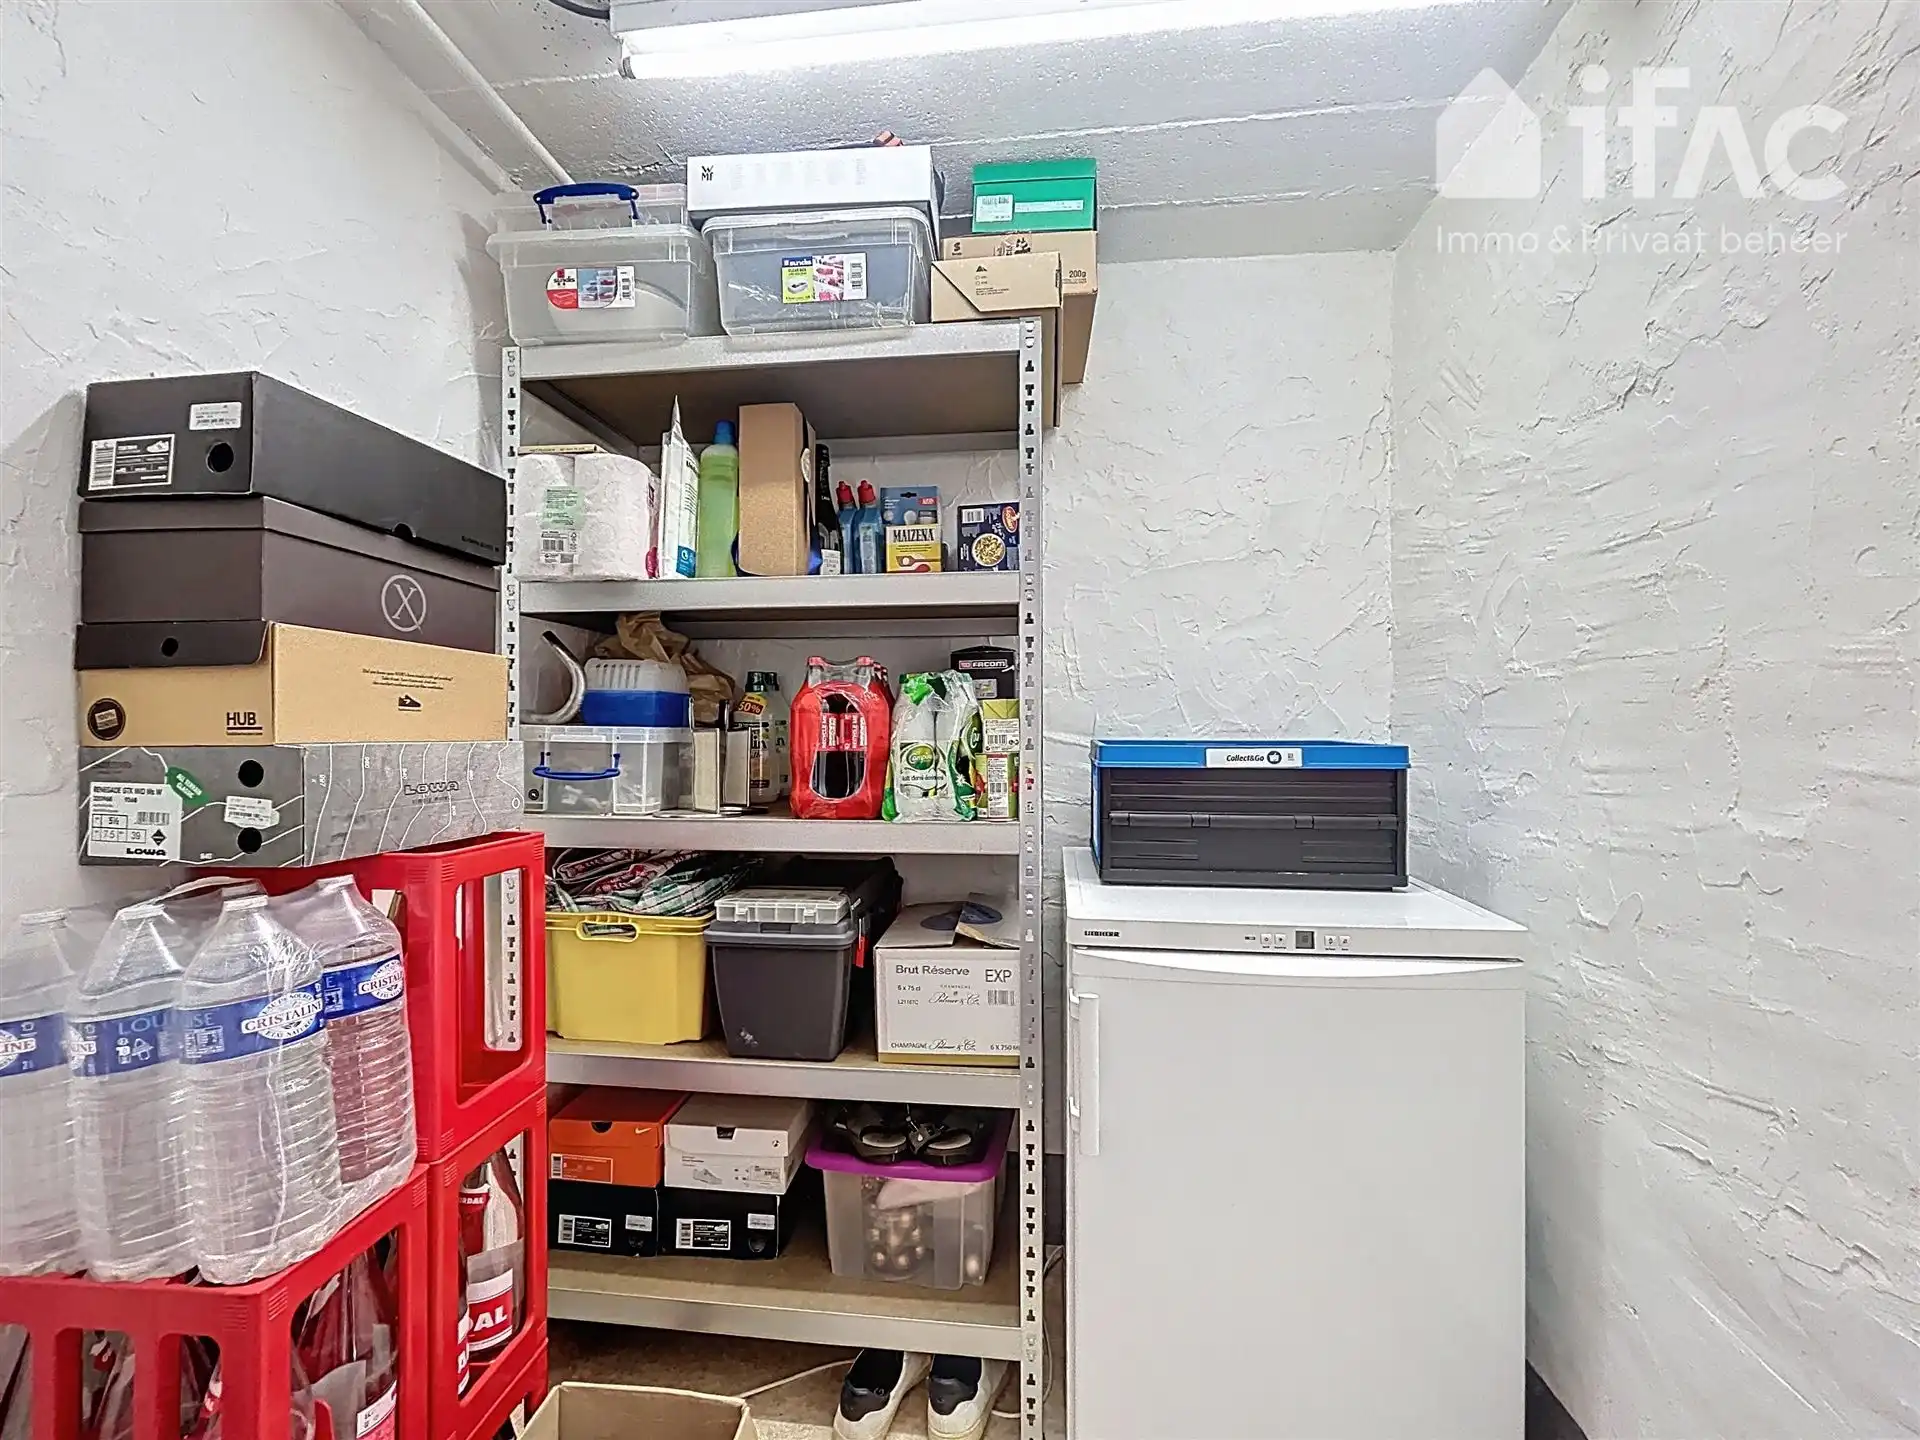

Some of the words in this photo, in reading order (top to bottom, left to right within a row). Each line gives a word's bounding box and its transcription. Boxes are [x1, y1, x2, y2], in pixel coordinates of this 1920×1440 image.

[1069, 270, 1087, 278] 200g
[893, 528, 935, 542] MAIZENA
[226, 712, 257, 725] HUB
[1226, 754, 1265, 762] Collect&Go
[404, 780, 460, 796] LOWA
[131, 831, 141, 840] 39
[126, 848, 166, 856] LOWA
[896, 964, 919, 975] Brut
[922, 965, 970, 976] Réserve
[985, 969, 1012, 983] EXP
